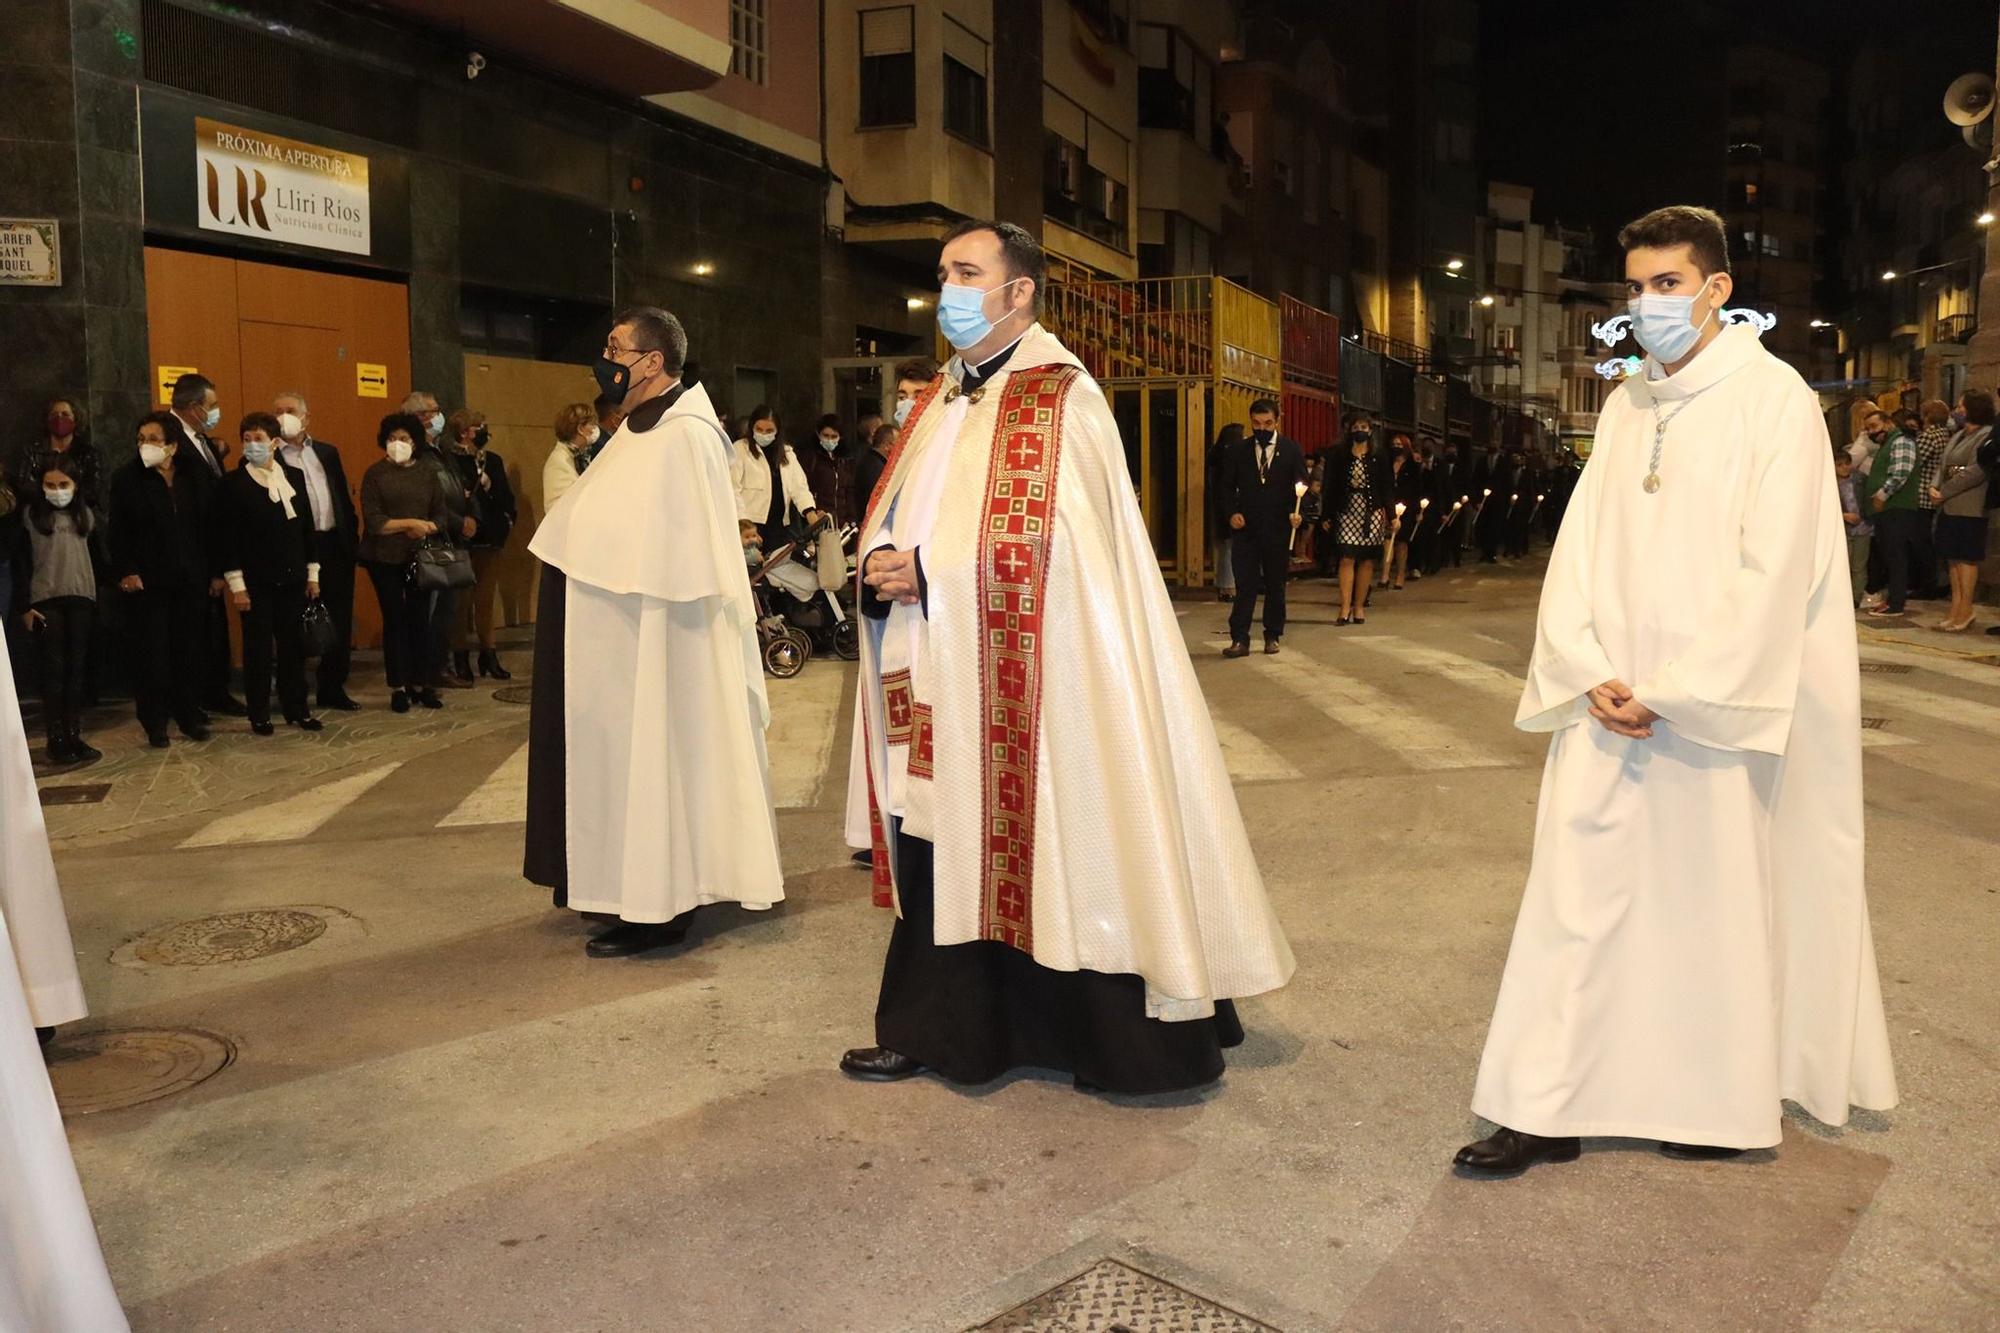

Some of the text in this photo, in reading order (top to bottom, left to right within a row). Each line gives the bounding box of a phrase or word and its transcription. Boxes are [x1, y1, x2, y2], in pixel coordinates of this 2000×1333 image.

[217, 132, 352, 176] PRÓXIMA APERTURA
[276, 187, 316, 215] Lliri
[0, 246, 24, 258] SANT
